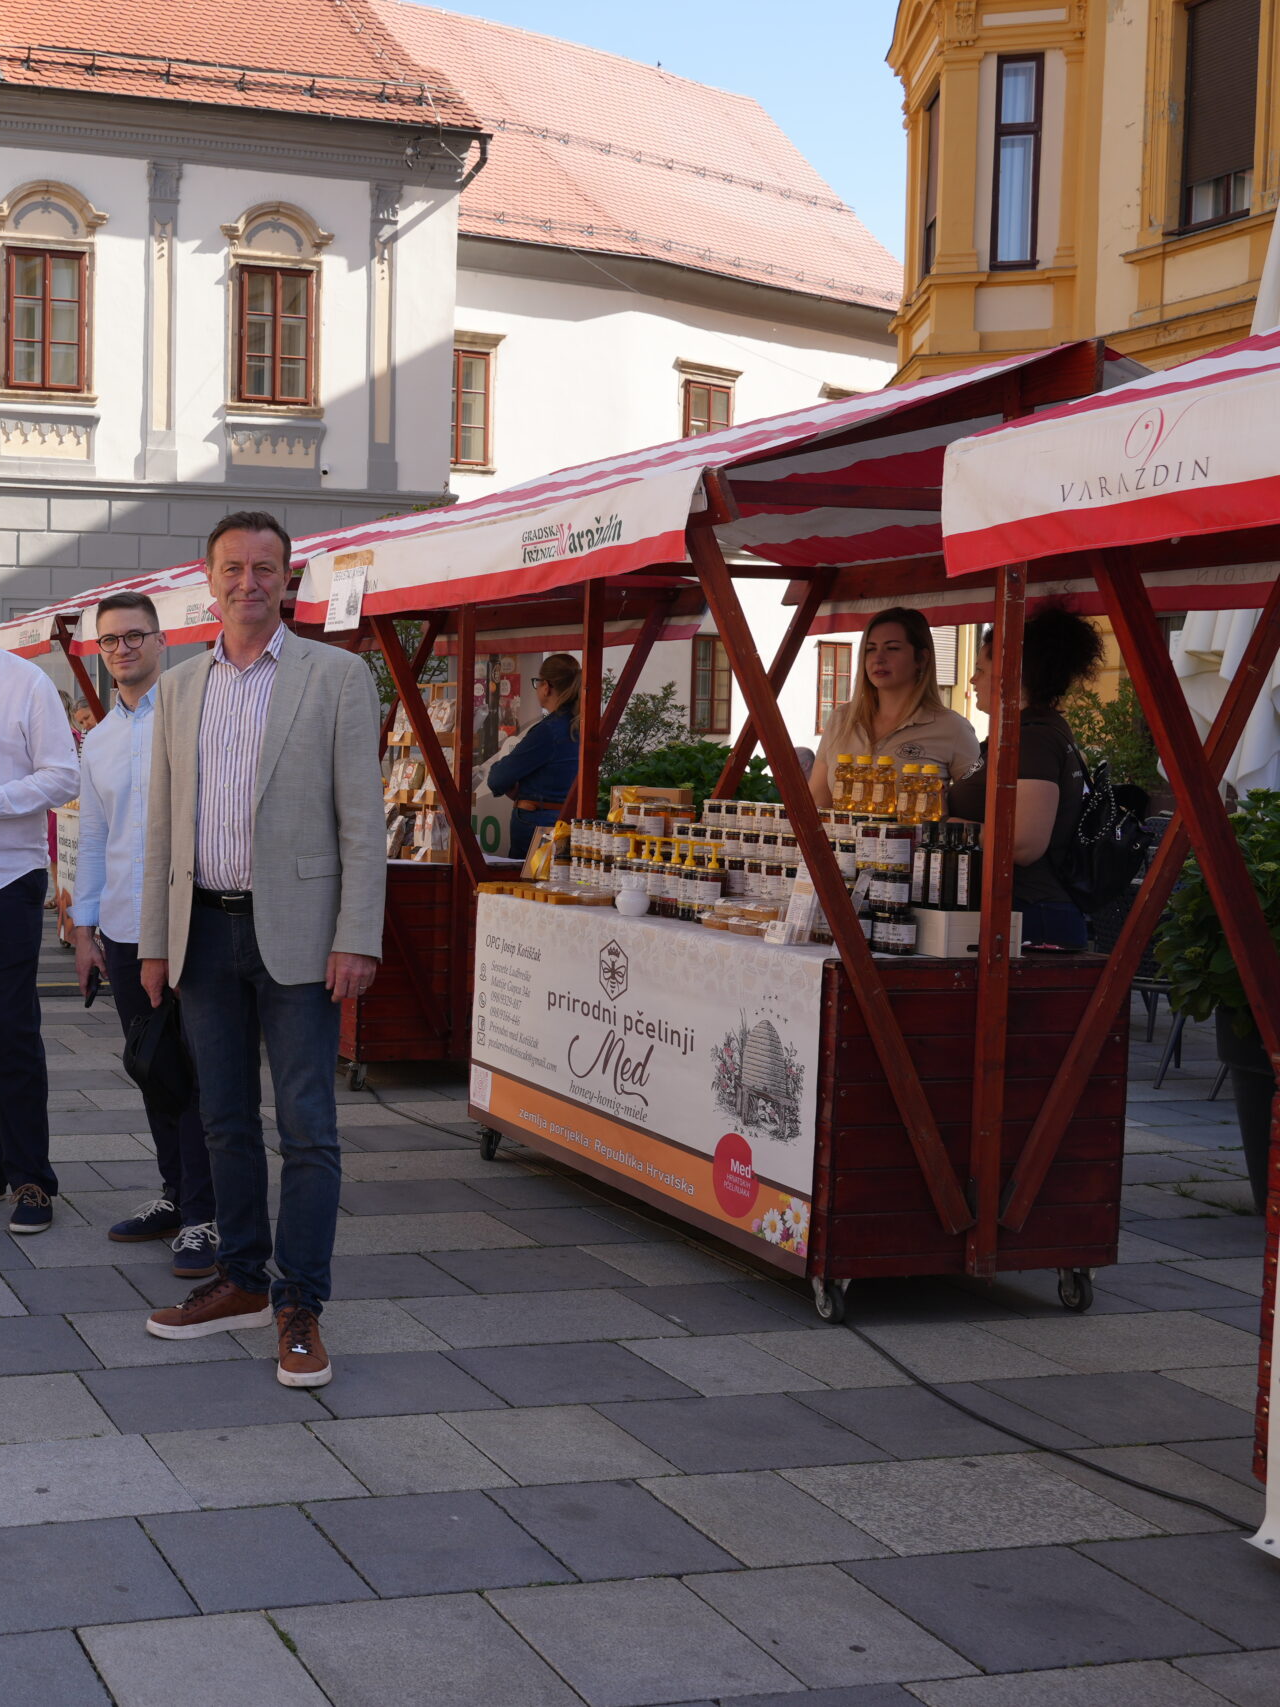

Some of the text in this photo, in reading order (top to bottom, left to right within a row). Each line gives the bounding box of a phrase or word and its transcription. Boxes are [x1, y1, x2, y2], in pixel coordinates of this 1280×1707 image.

[559, 513, 623, 556] Varaždin
[485, 934, 501, 950] OPG
[501, 938, 516, 957] Josip
[547, 990, 695, 1056] prirodni pčelinji
[567, 1029, 655, 1107] Med
[569, 1079, 649, 1124] honey-honig-miele
[519, 1108, 696, 1196] zemlja porijekla: Republika Hrvatska
[730, 1158, 752, 1179] Med
